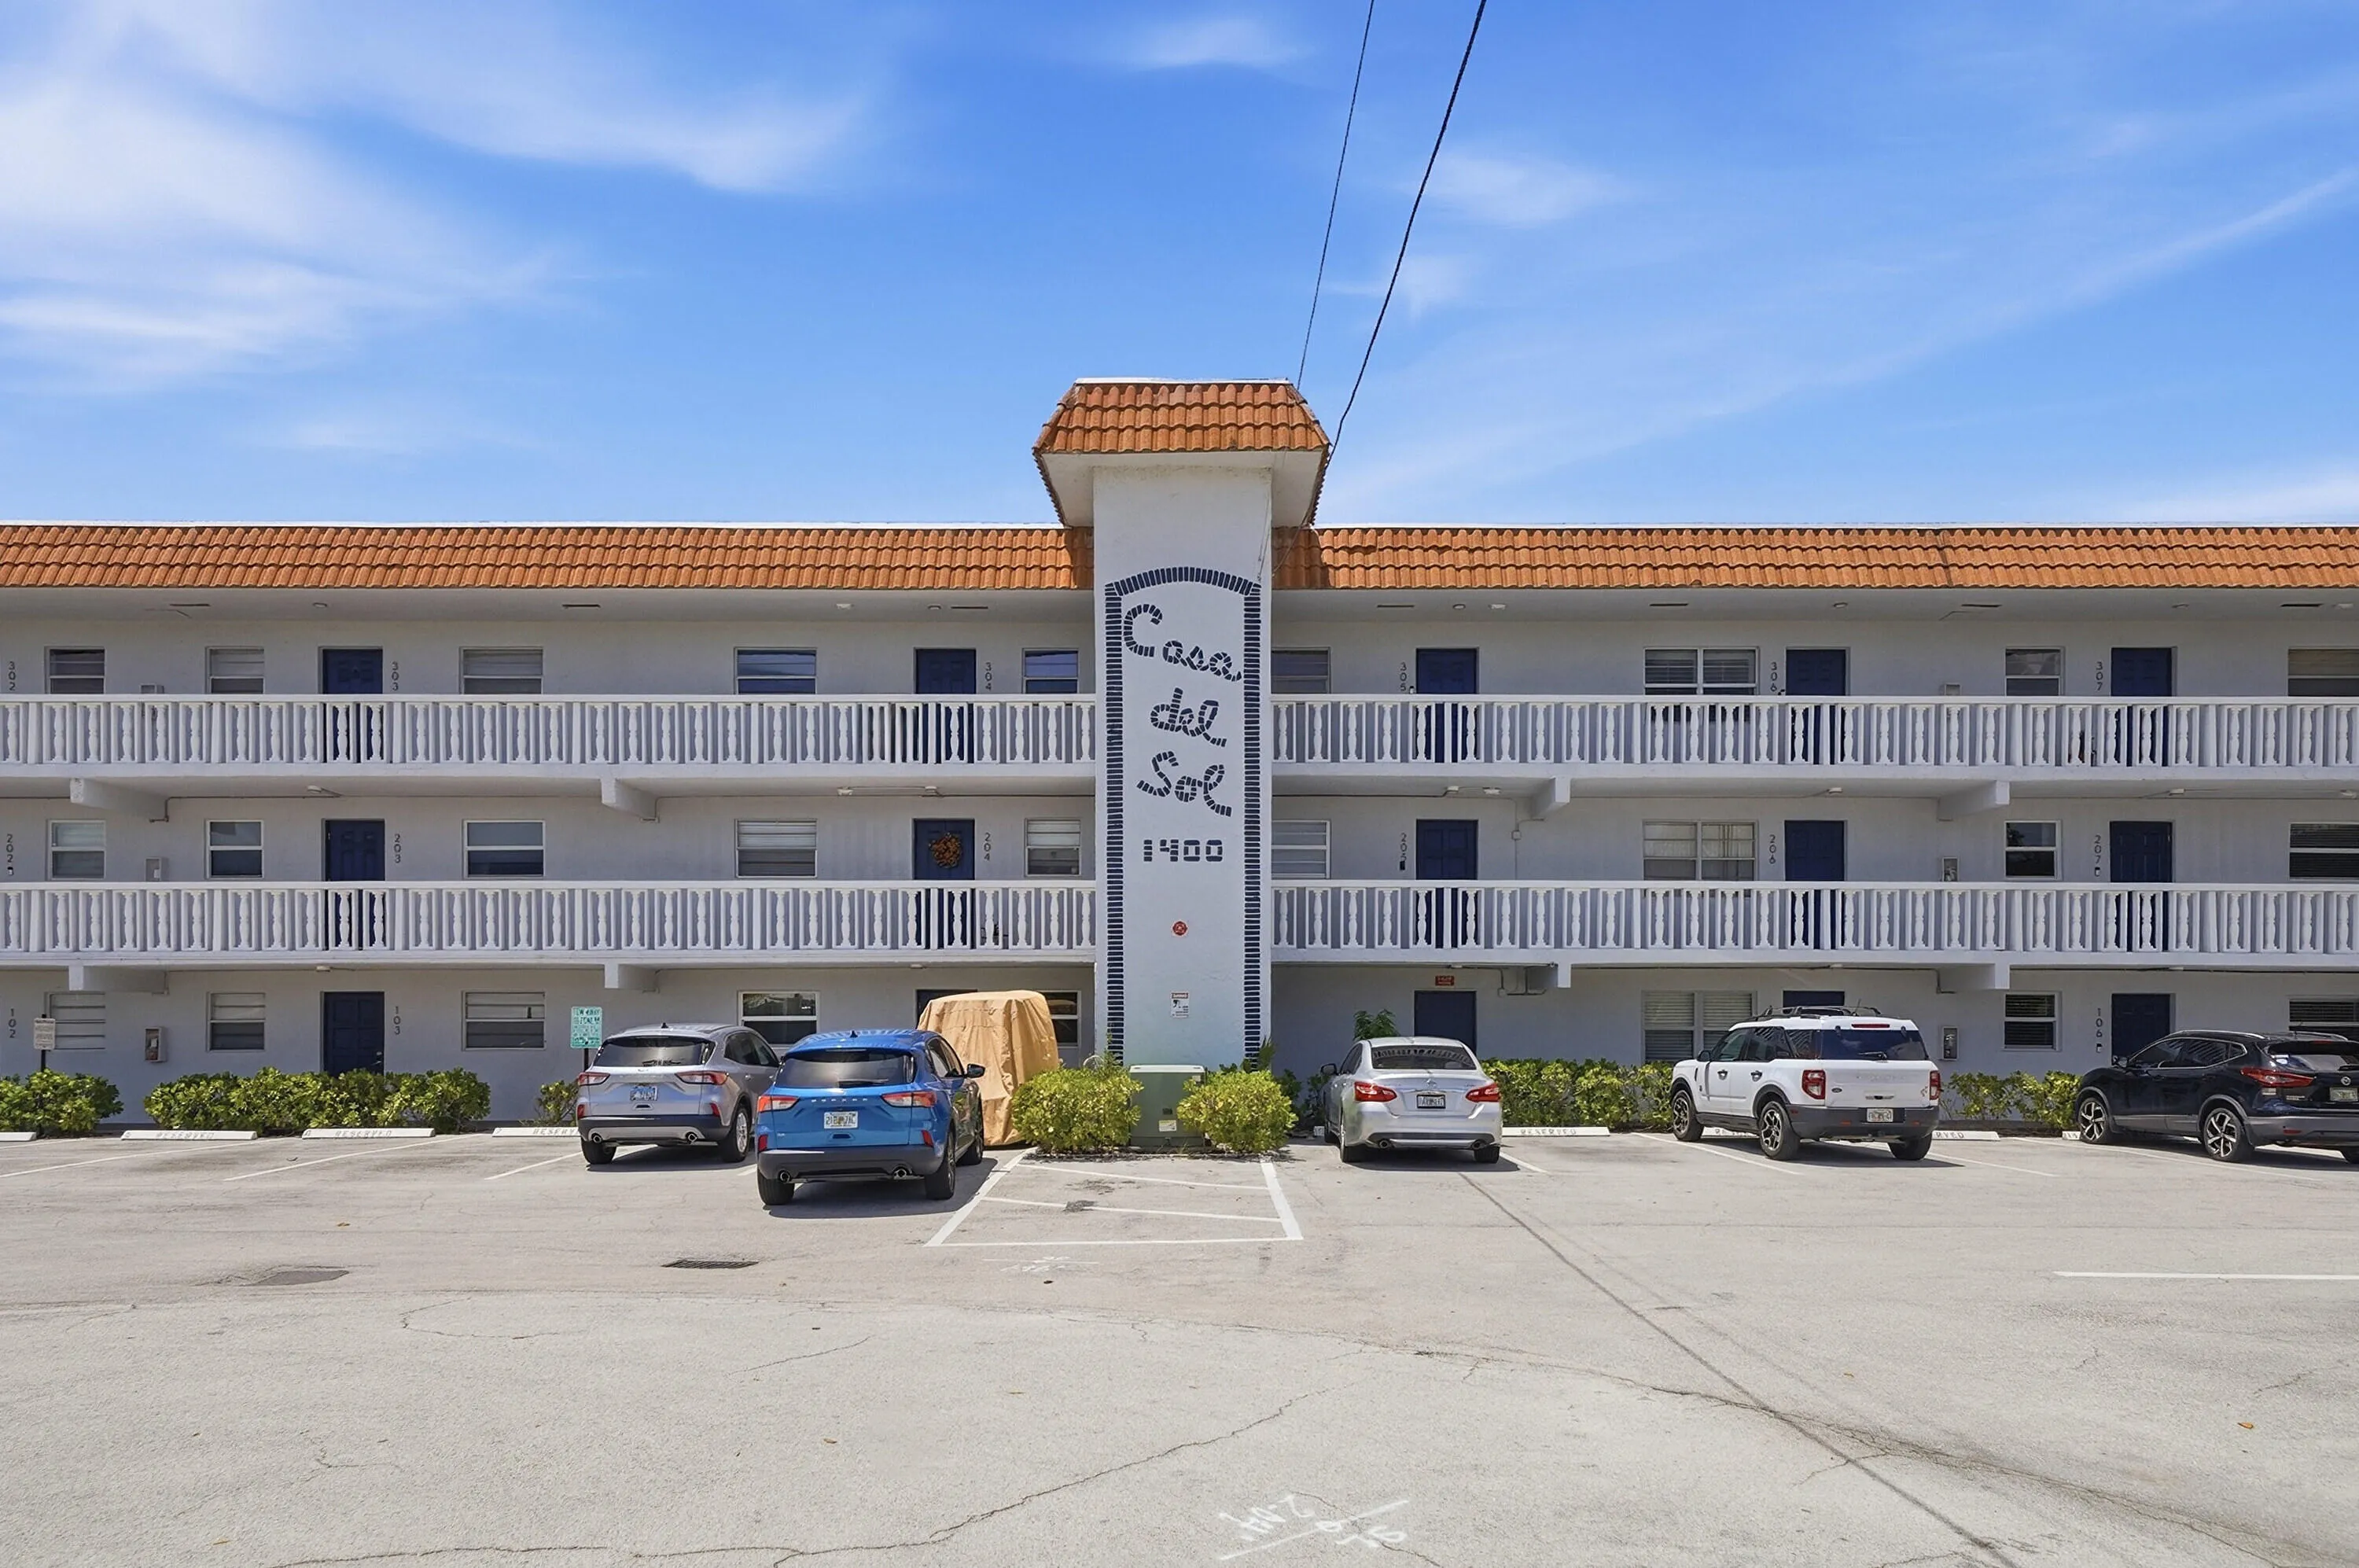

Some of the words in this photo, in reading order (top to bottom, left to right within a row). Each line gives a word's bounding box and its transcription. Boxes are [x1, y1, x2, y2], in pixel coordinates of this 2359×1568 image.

[1124, 603, 1242, 682] Casa
[8, 661, 17, 691] 302
[2095, 661, 2103, 691] 307
[1150, 687, 1227, 747] del
[1137, 750, 1231, 817] Sol
[393, 834, 402, 863] 203
[983, 832, 992, 862] 204
[1144, 839, 1223, 862] 1400
[1768, 834, 1777, 865] 206
[8, 1008, 17, 1039] 102
[2095, 1008, 2103, 1038] 106
